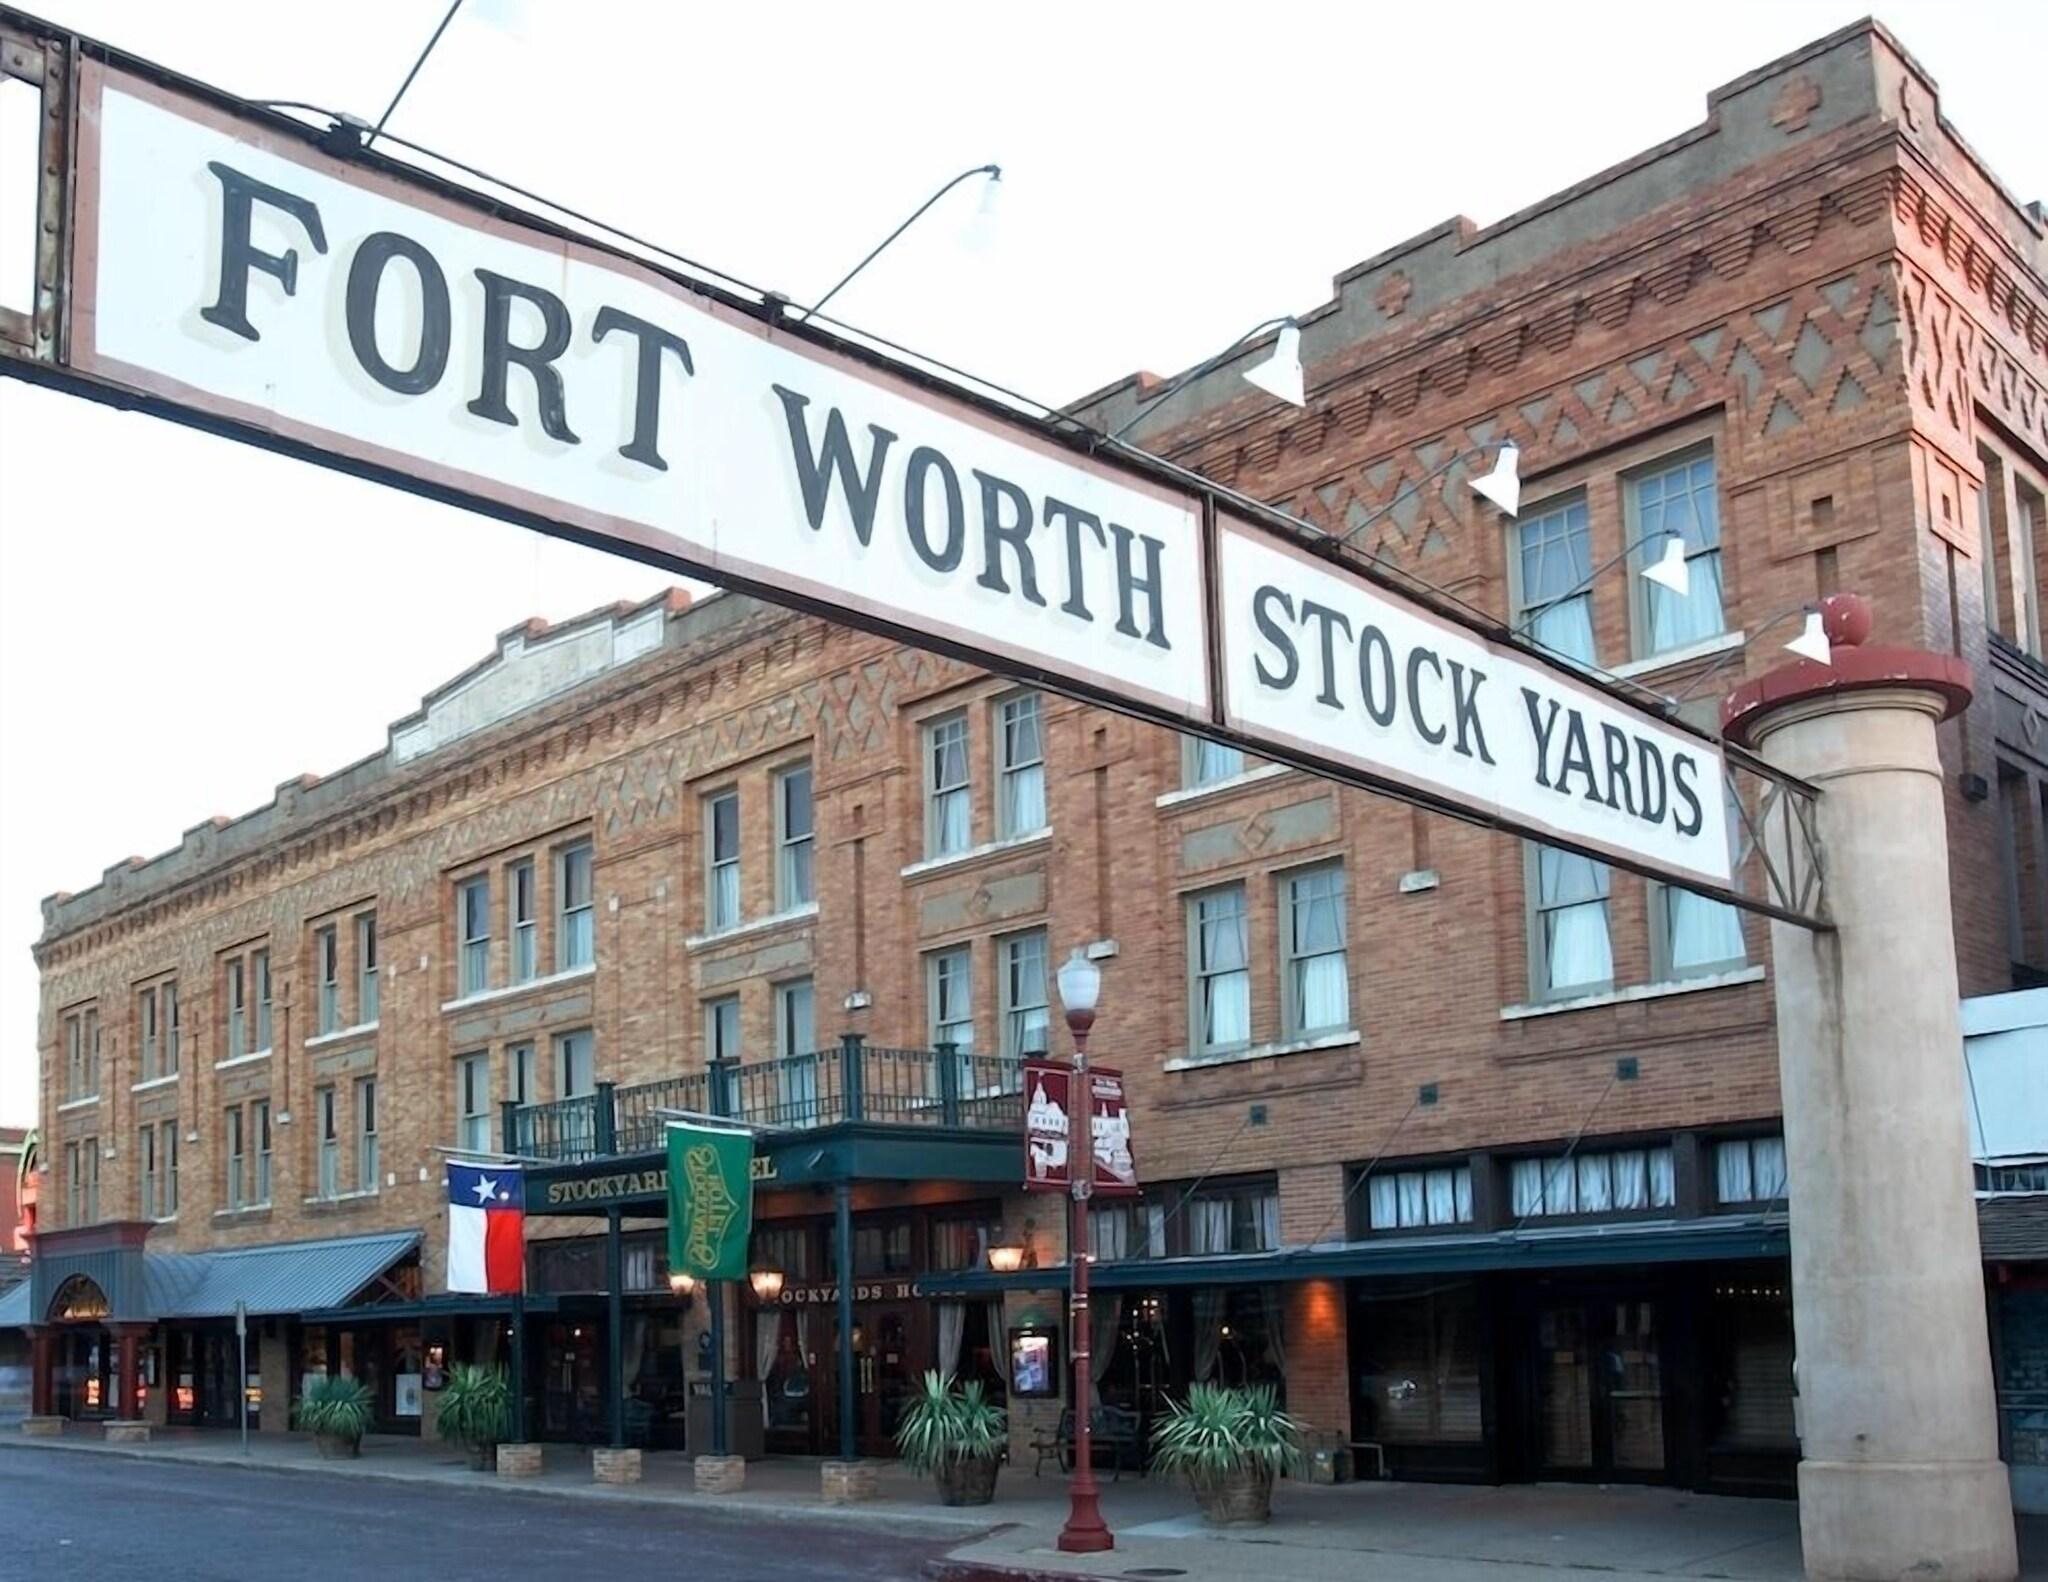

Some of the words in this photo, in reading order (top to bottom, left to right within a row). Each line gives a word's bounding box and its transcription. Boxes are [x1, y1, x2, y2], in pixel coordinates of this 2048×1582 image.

[201, 160, 694, 471] FORT
[772, 383, 1171, 650] WORTH
[1253, 585, 1496, 764] STOCK
[1520, 687, 1704, 838] YARDS
